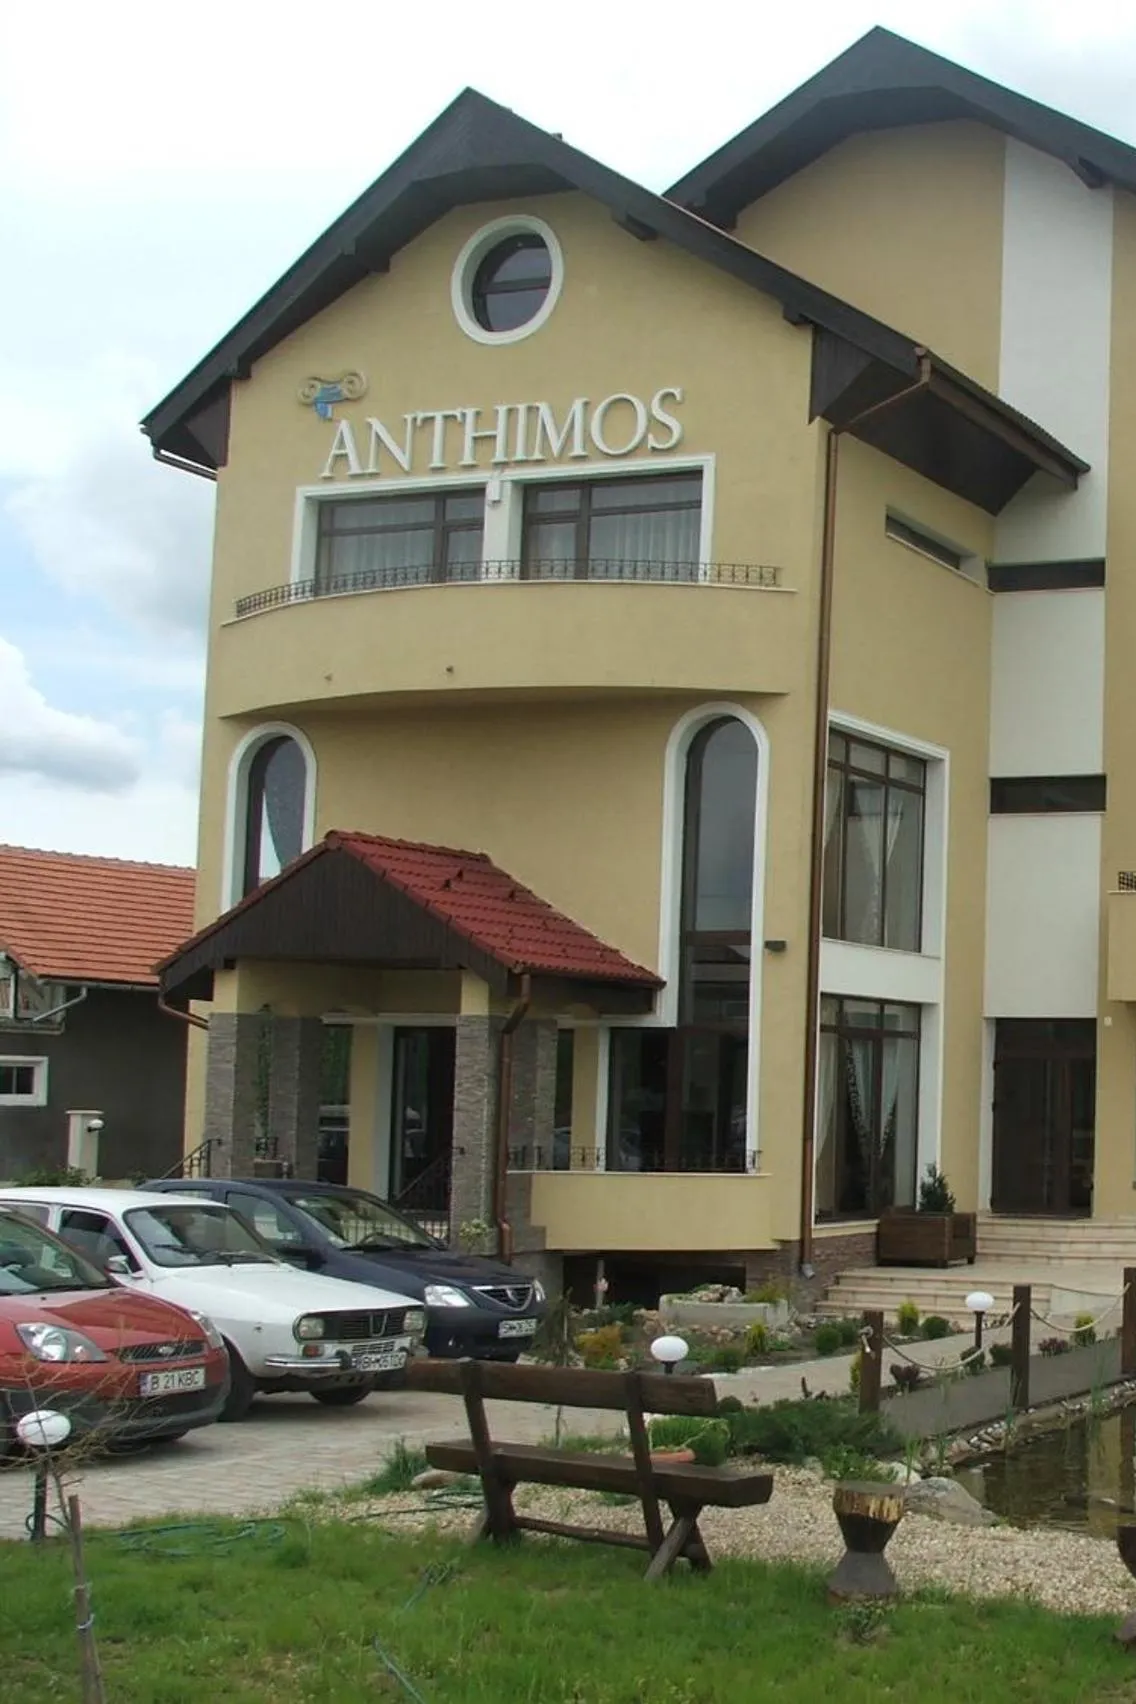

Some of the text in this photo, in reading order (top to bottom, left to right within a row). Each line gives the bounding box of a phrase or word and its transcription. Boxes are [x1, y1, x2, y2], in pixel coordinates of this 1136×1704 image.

[319, 388, 684, 480] ANTHIMOS
[151, 1376, 159, 1390] B
[163, 1373, 175, 1389] 21
